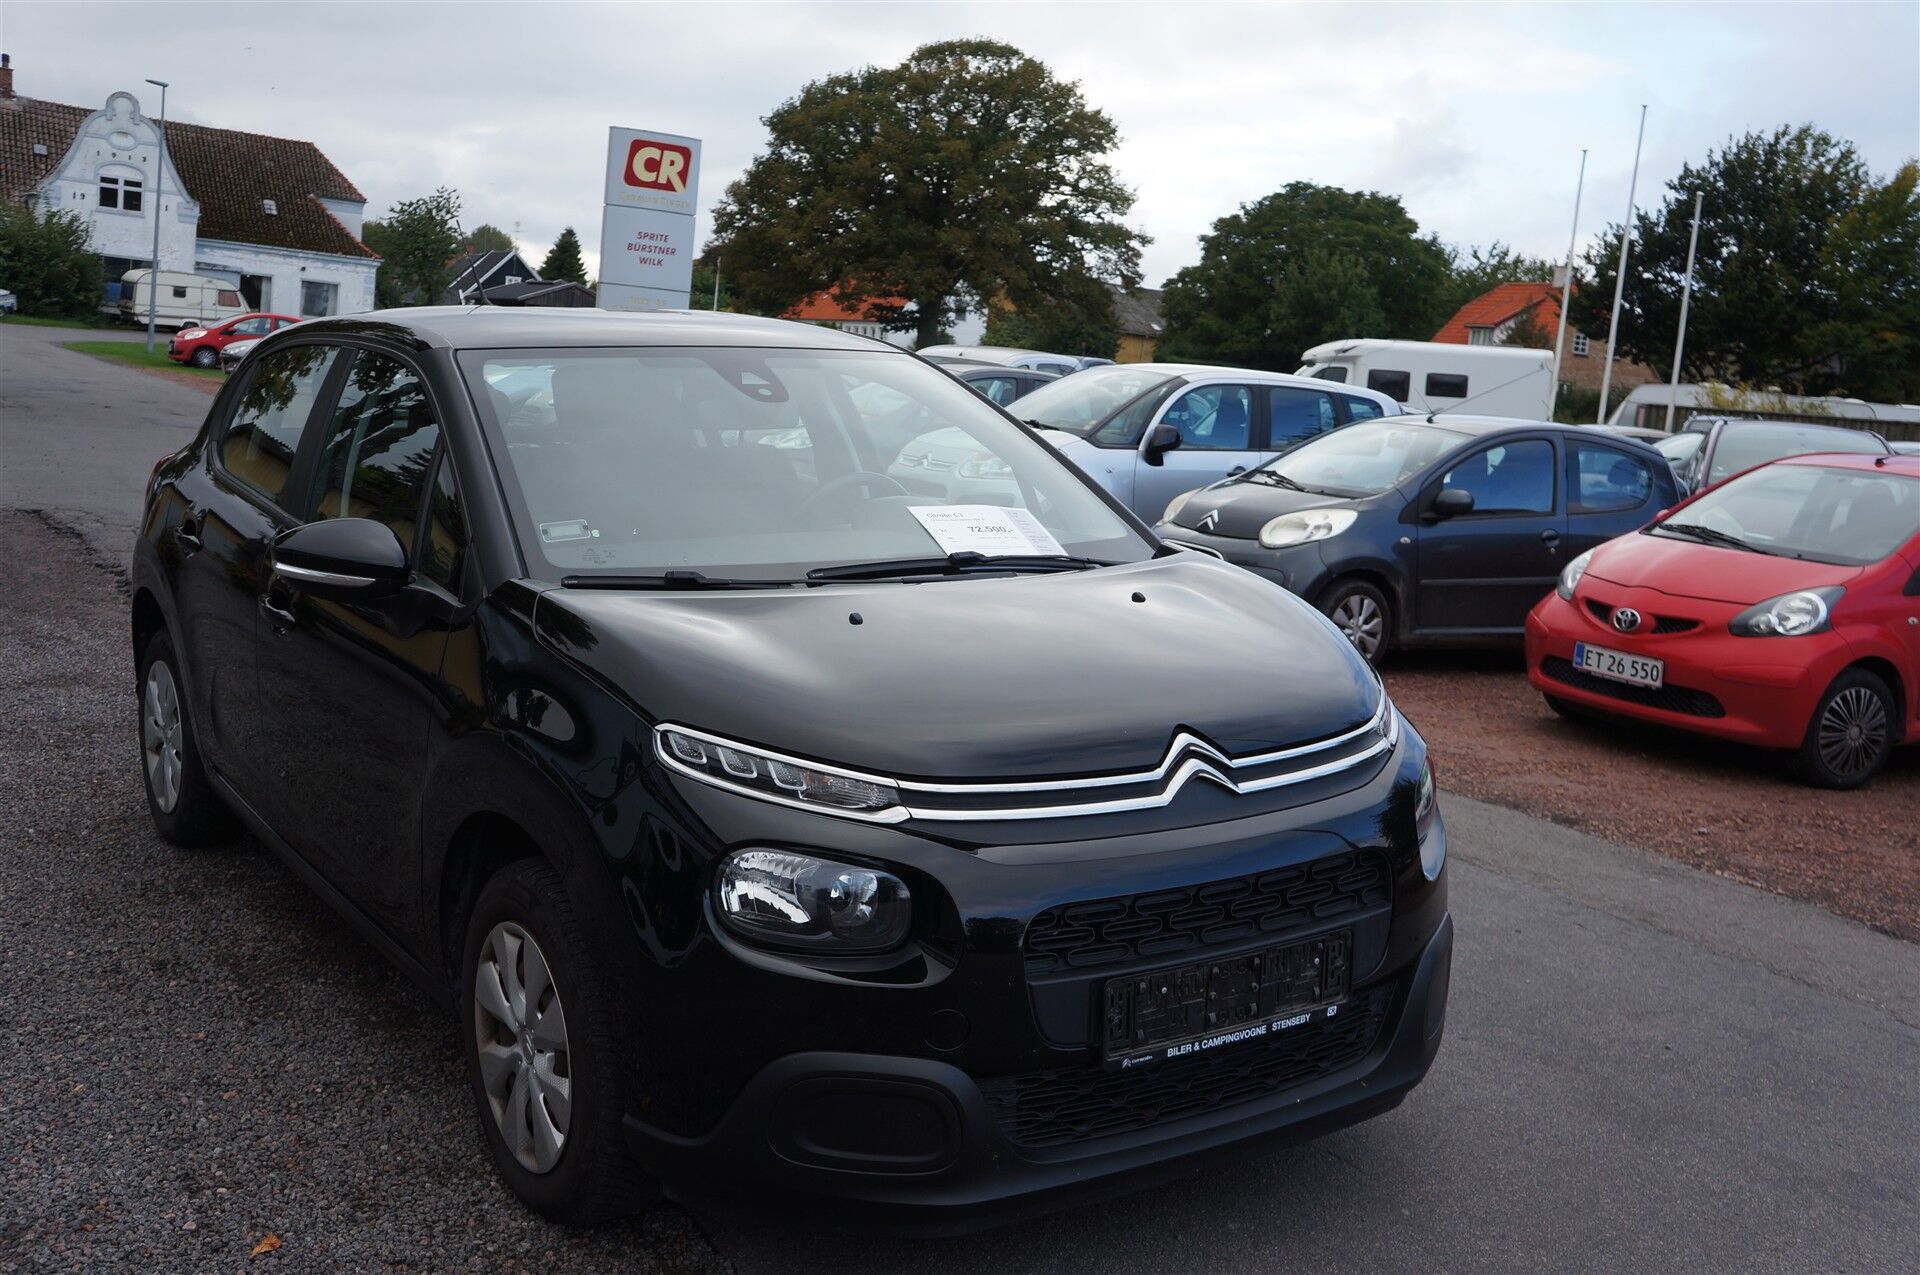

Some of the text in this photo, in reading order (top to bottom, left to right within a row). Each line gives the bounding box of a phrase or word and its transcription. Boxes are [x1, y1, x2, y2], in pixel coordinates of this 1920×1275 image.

[632, 146, 686, 193] CR
[637, 231, 670, 243] SPRITE
[639, 256, 664, 267] WILK
[1585, 649, 1660, 682] ET 26 550
[1167, 1012, 1312, 1058] BILER & CAMPINGVOGNE STENSEBY
